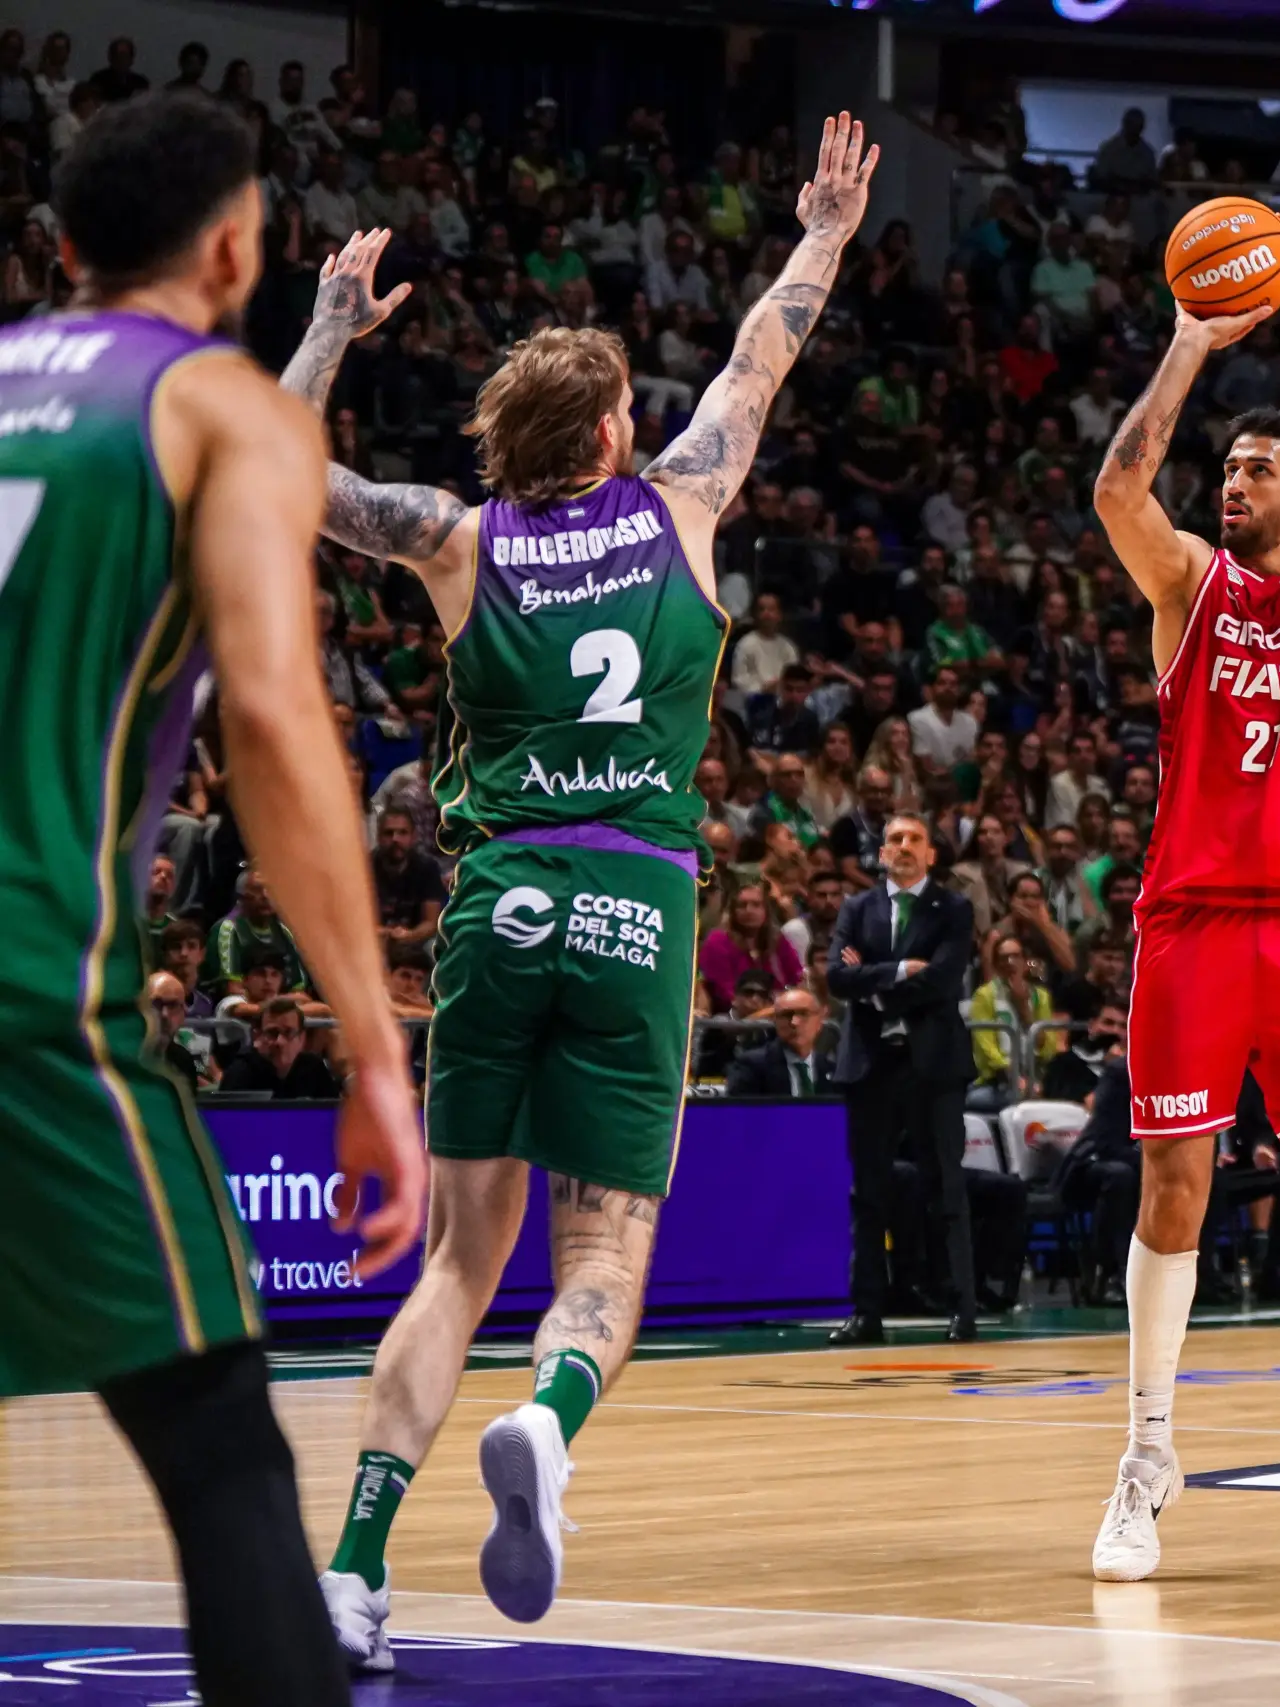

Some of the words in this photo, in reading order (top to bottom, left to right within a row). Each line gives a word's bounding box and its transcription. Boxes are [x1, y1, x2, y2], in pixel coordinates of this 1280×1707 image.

[1190, 244, 1277, 289] Wilson
[493, 509, 665, 567] BALCEROWSKI
[570, 627, 643, 724] 2
[520, 753, 674, 797] Andalucía
[567, 913, 614, 937] DEL
[617, 922, 661, 952] SOL
[572, 892, 664, 932] COSTA
[564, 934, 656, 972] MÁLAGA
[1150, 1089, 1209, 1119] YOSOY
[269, 1248, 364, 1291] travel
